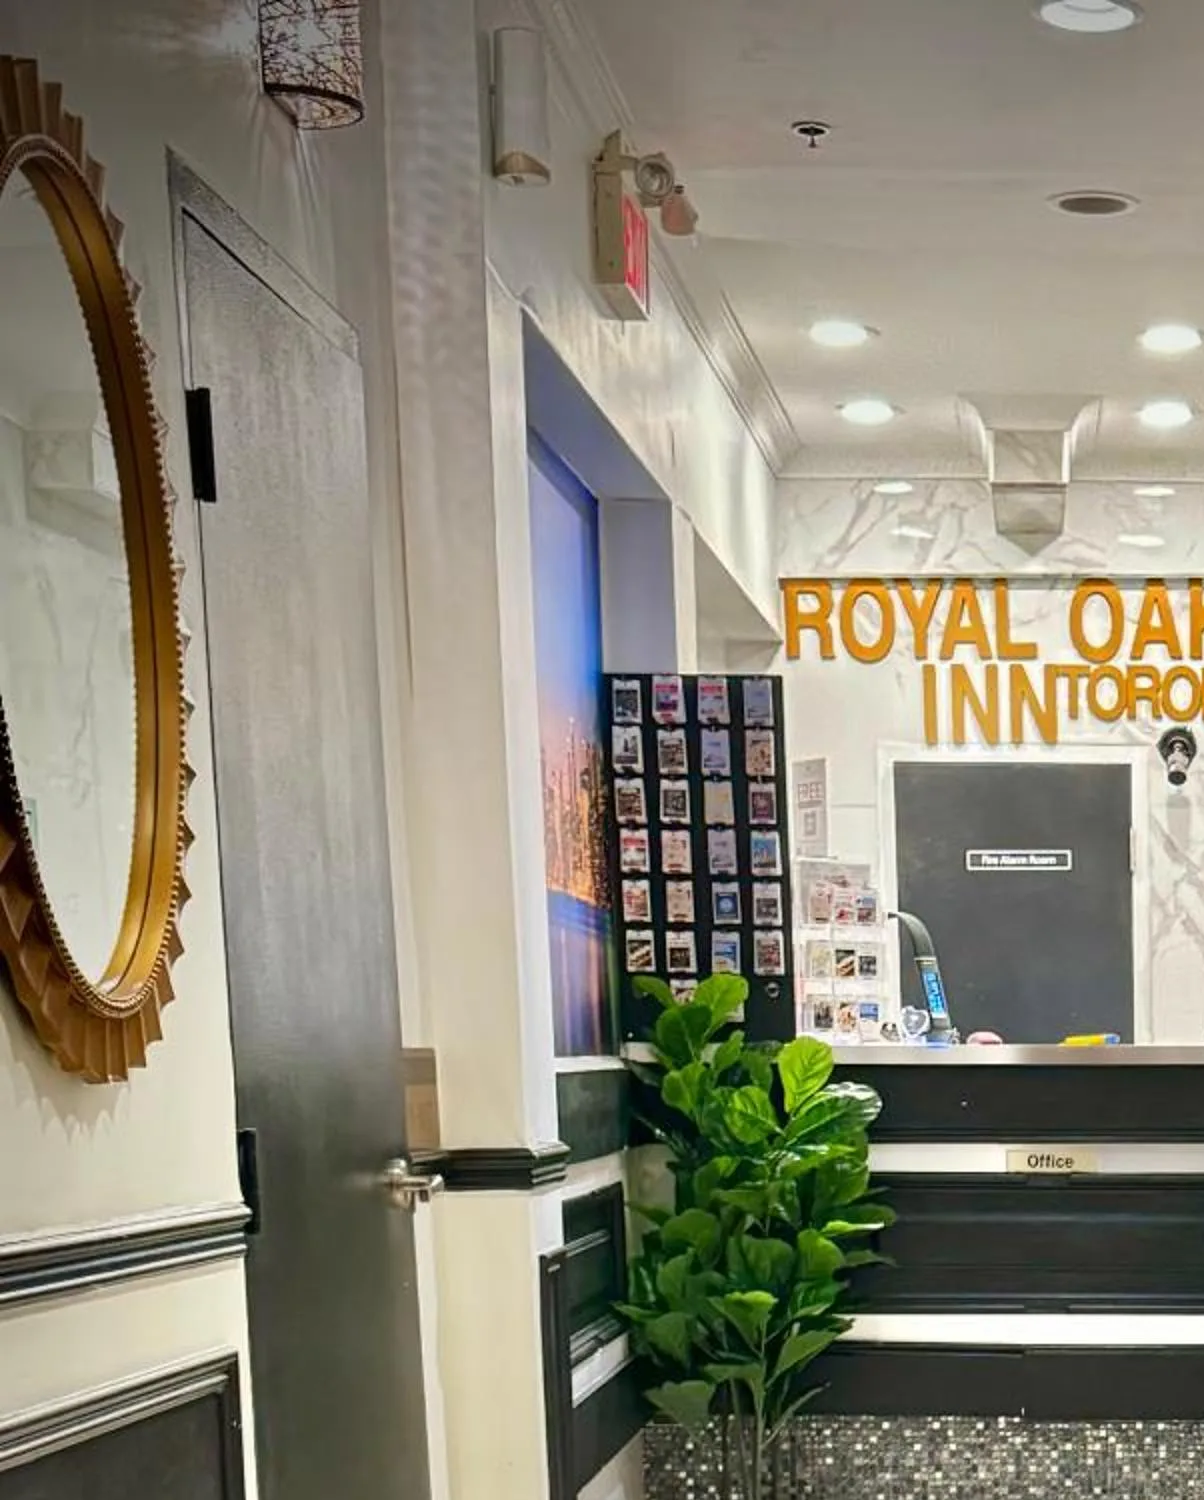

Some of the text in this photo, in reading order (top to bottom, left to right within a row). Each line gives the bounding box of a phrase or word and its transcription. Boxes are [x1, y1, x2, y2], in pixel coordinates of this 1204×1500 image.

[780, 577, 1038, 664] ROYAL
[921, 664, 1059, 746] INN
[1000, 855, 1028, 865] Alarm
[1029, 855, 1057, 865] Room
[1027, 1154, 1075, 1168] Office
